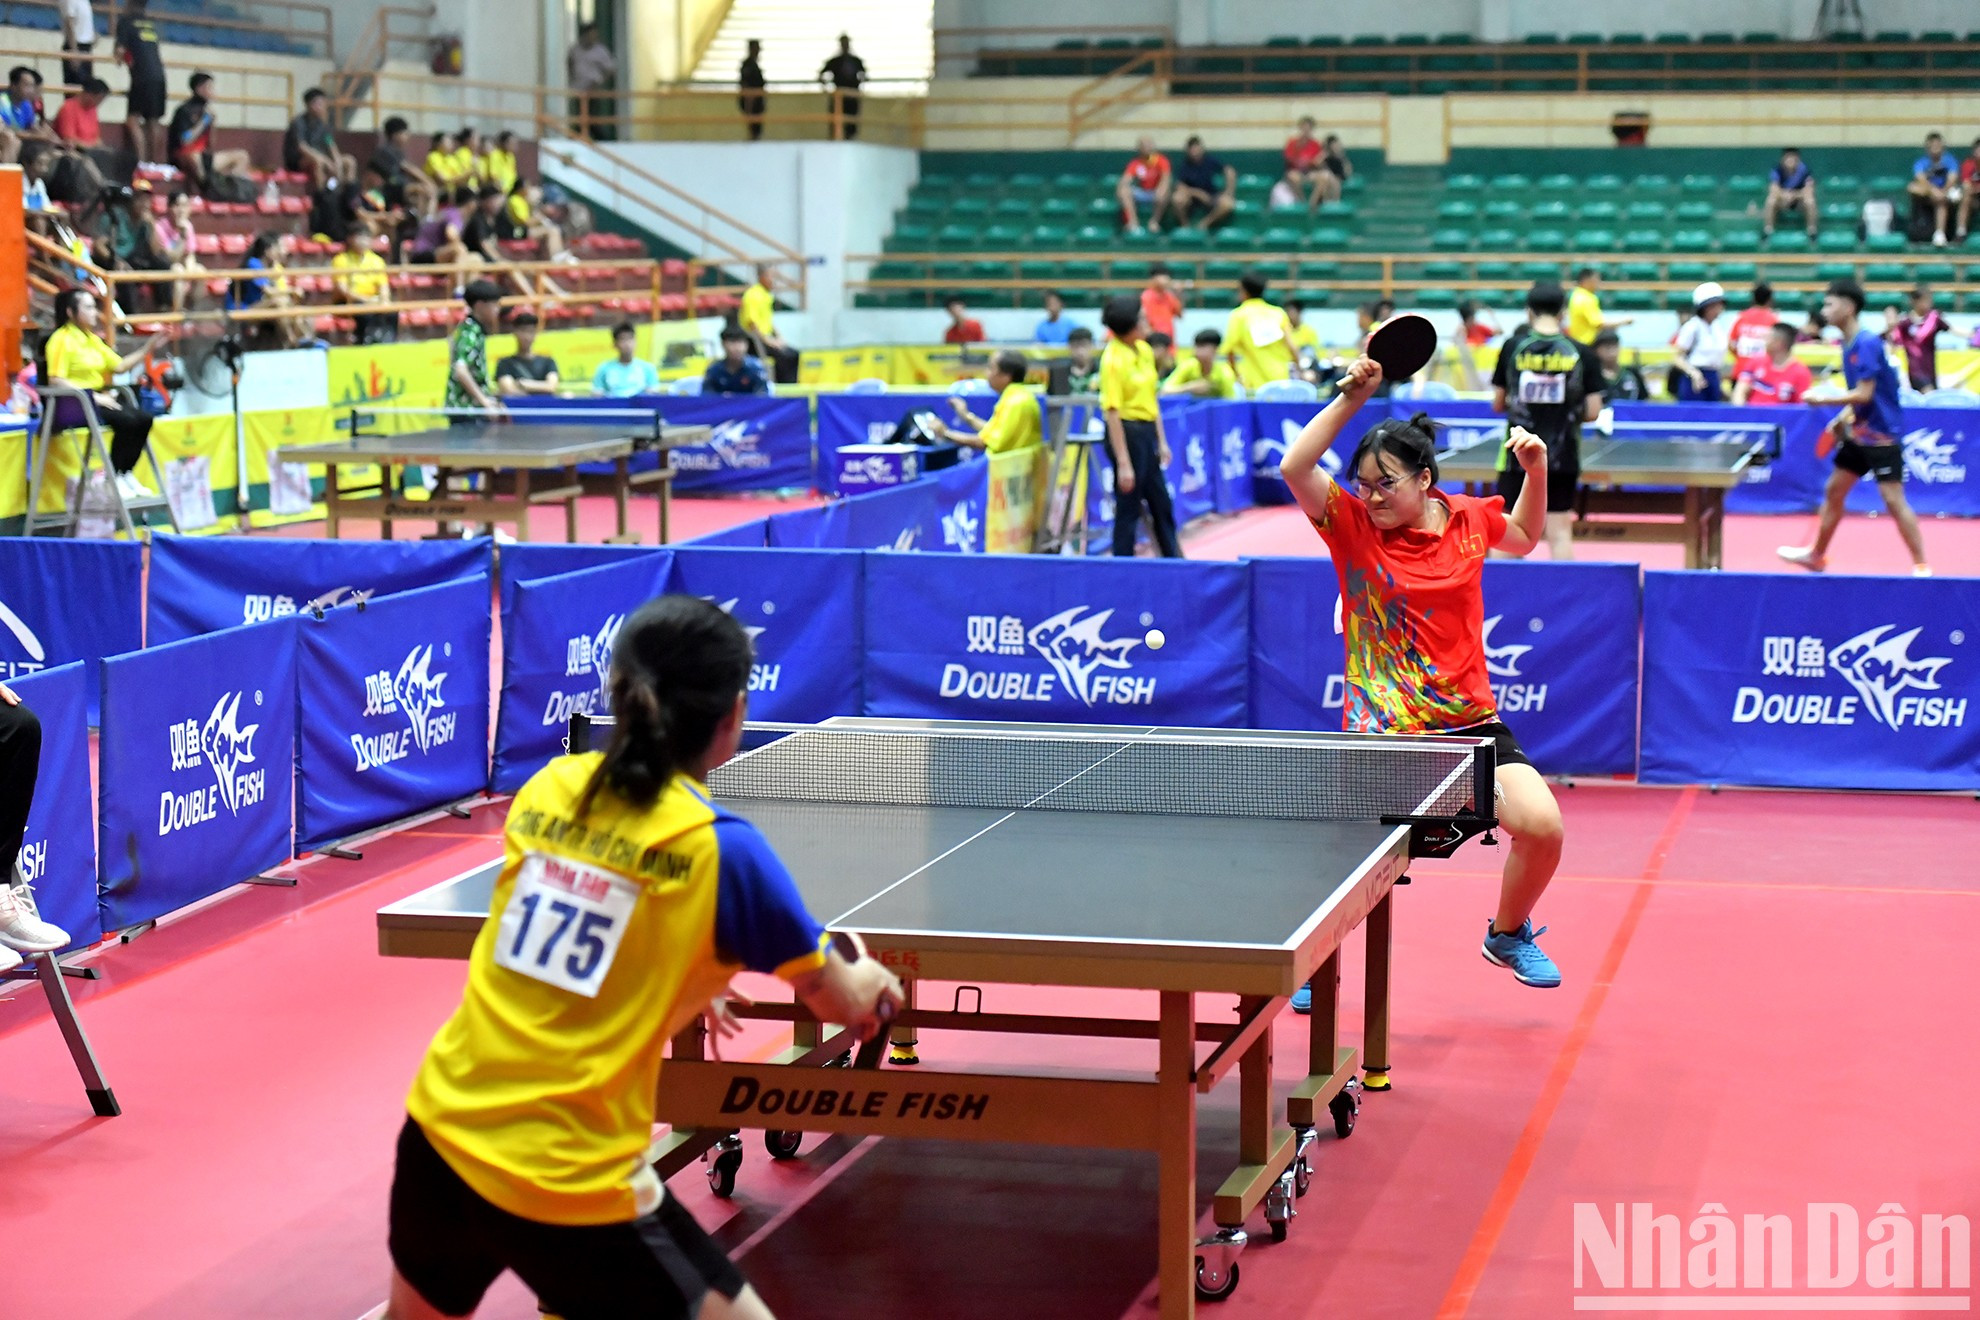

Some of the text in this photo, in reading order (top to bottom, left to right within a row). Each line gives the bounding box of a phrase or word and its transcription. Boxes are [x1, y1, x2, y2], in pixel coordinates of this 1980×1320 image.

[967, 615, 1025, 655] 双魚
[747, 664, 780, 691] SH
[1762, 636, 1826, 678] 双魚
[363, 669, 398, 717] 双魚
[939, 663, 1156, 705] DOUBLE FISH
[542, 688, 599, 726] DOUBLE
[1732, 686, 1968, 727] DOUBLE FISH
[169, 718, 202, 772] 双魚
[351, 711, 456, 772] DOUBLE FISH
[159, 768, 265, 836] DOUBLE FISH
[19, 840, 47, 883] ISH
[511, 892, 614, 980] 175
[720, 1076, 989, 1120] DOUBLE FISH
